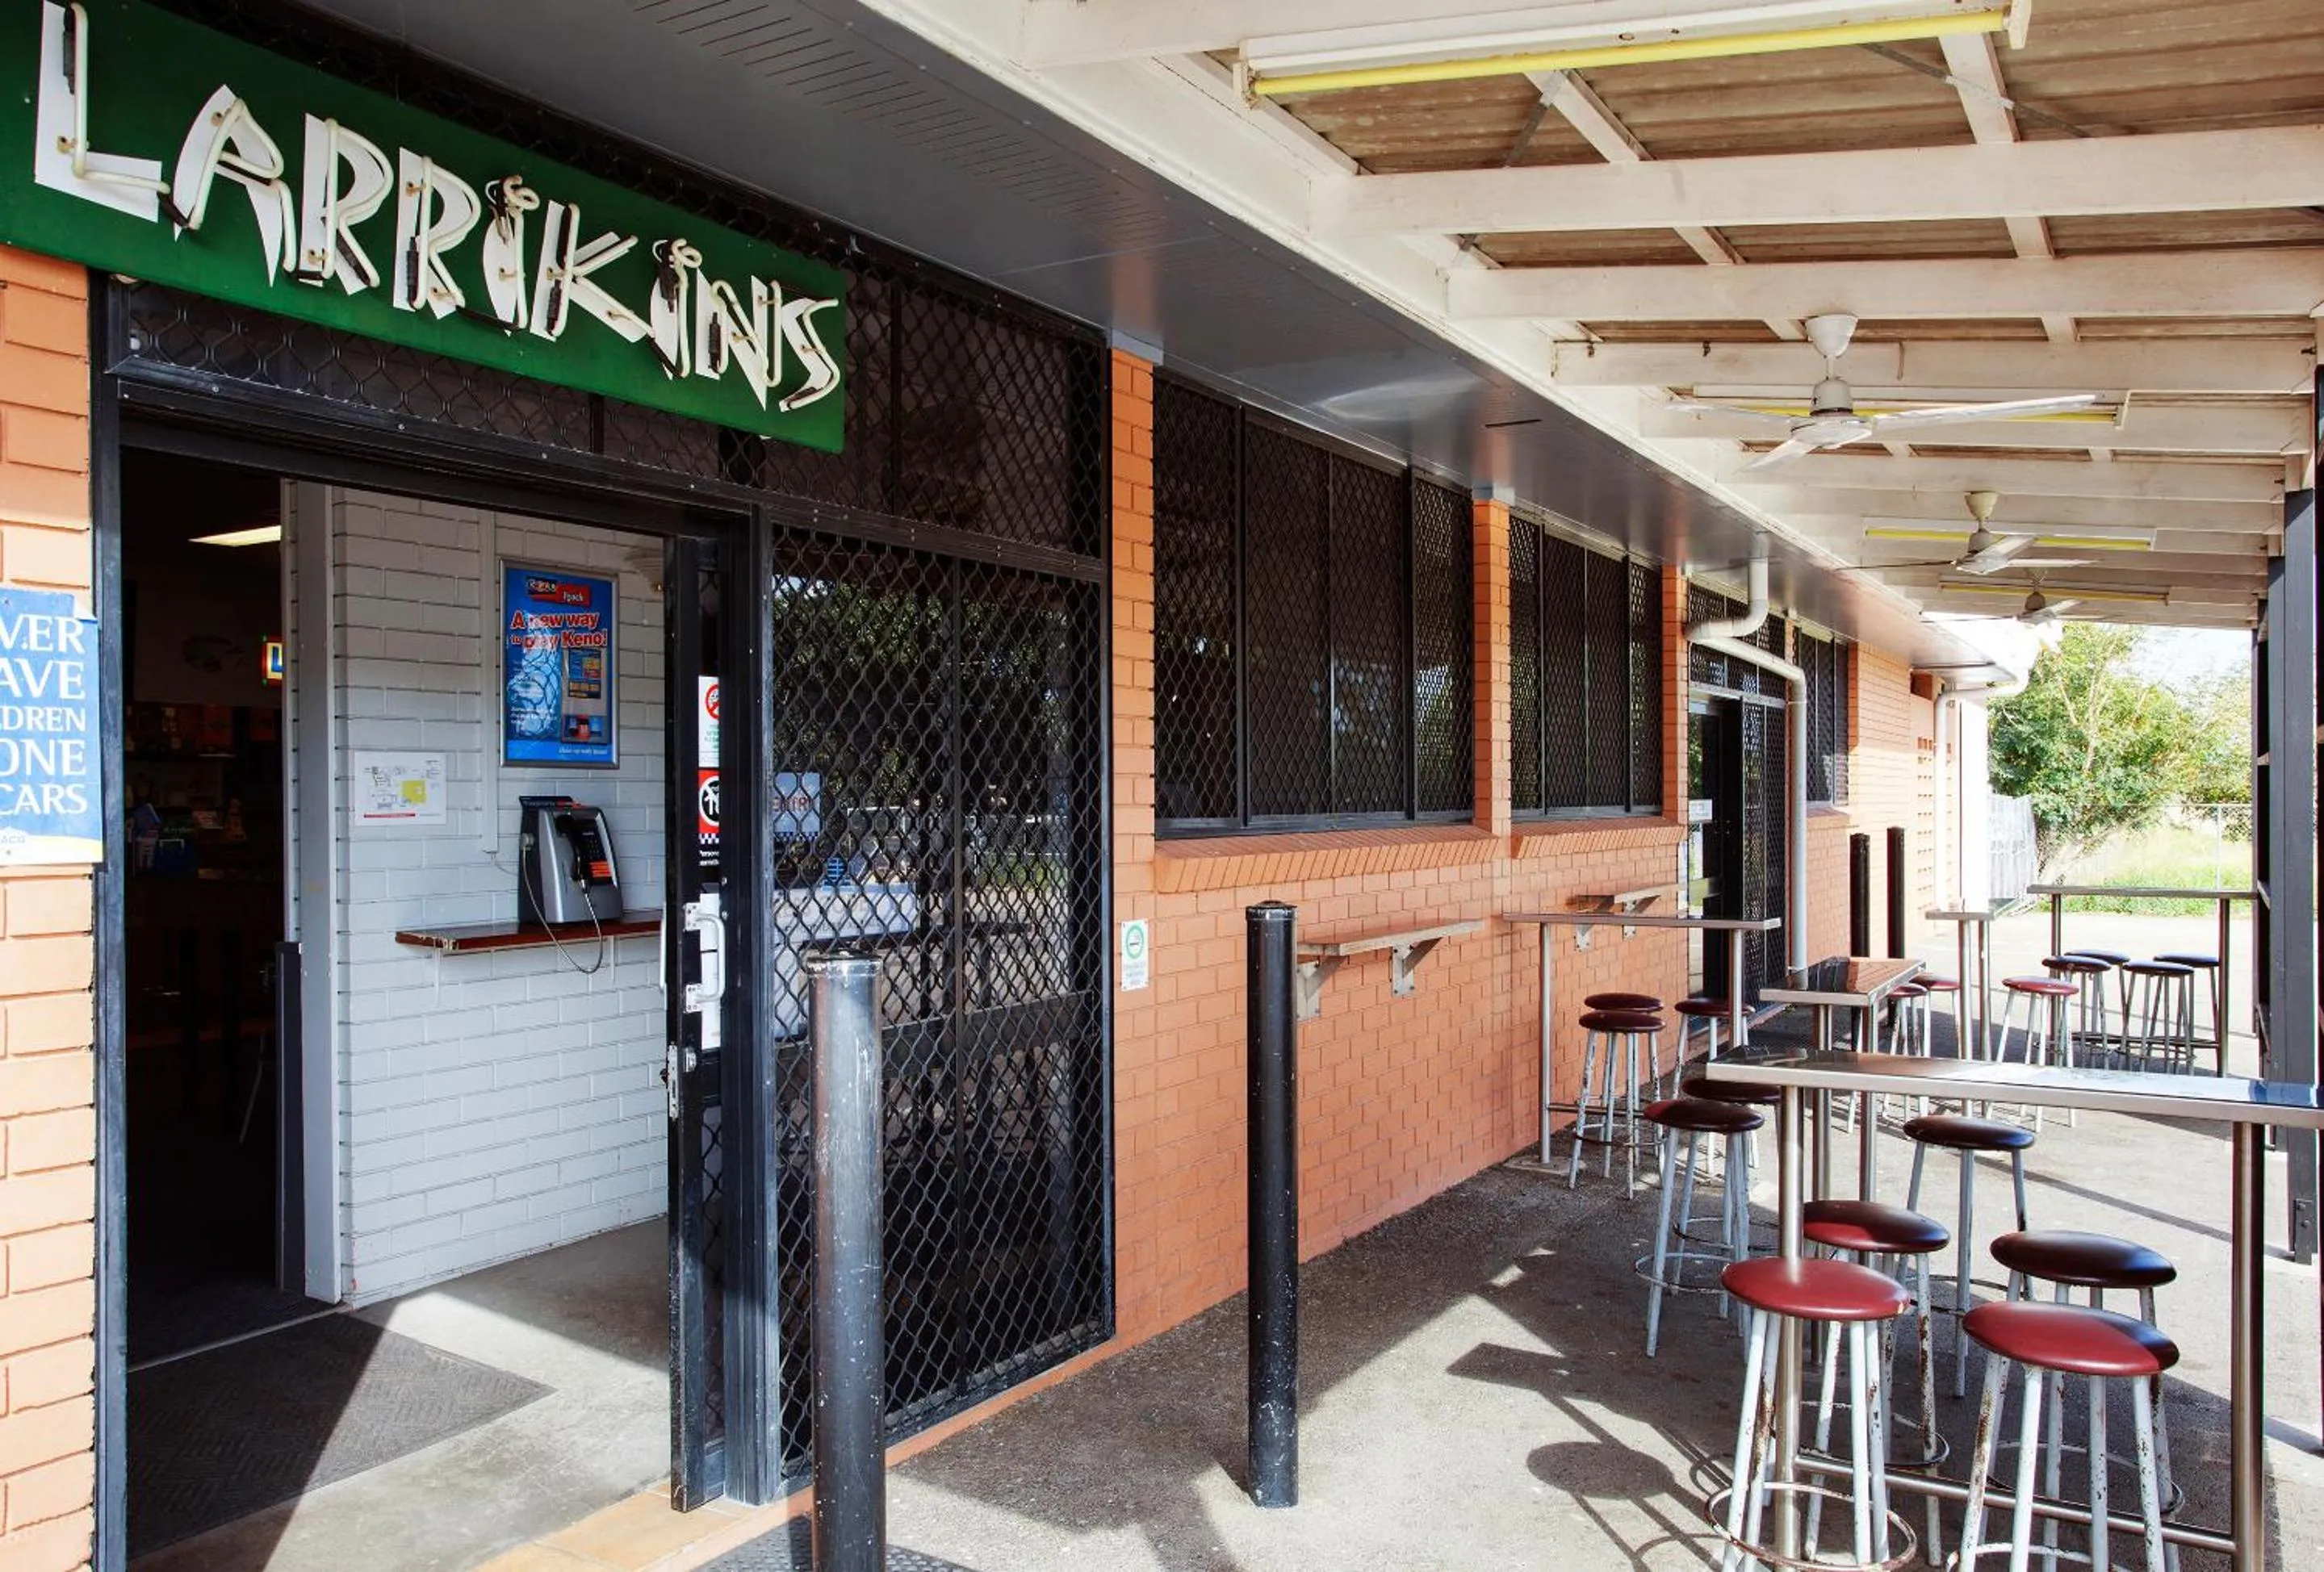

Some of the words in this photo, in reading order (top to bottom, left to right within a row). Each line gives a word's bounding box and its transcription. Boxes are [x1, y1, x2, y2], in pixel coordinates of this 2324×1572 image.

[0, 613, 86, 655] VER
[510, 609, 526, 629] A
[565, 612, 600, 630] way
[0, 657, 86, 700] AVE
